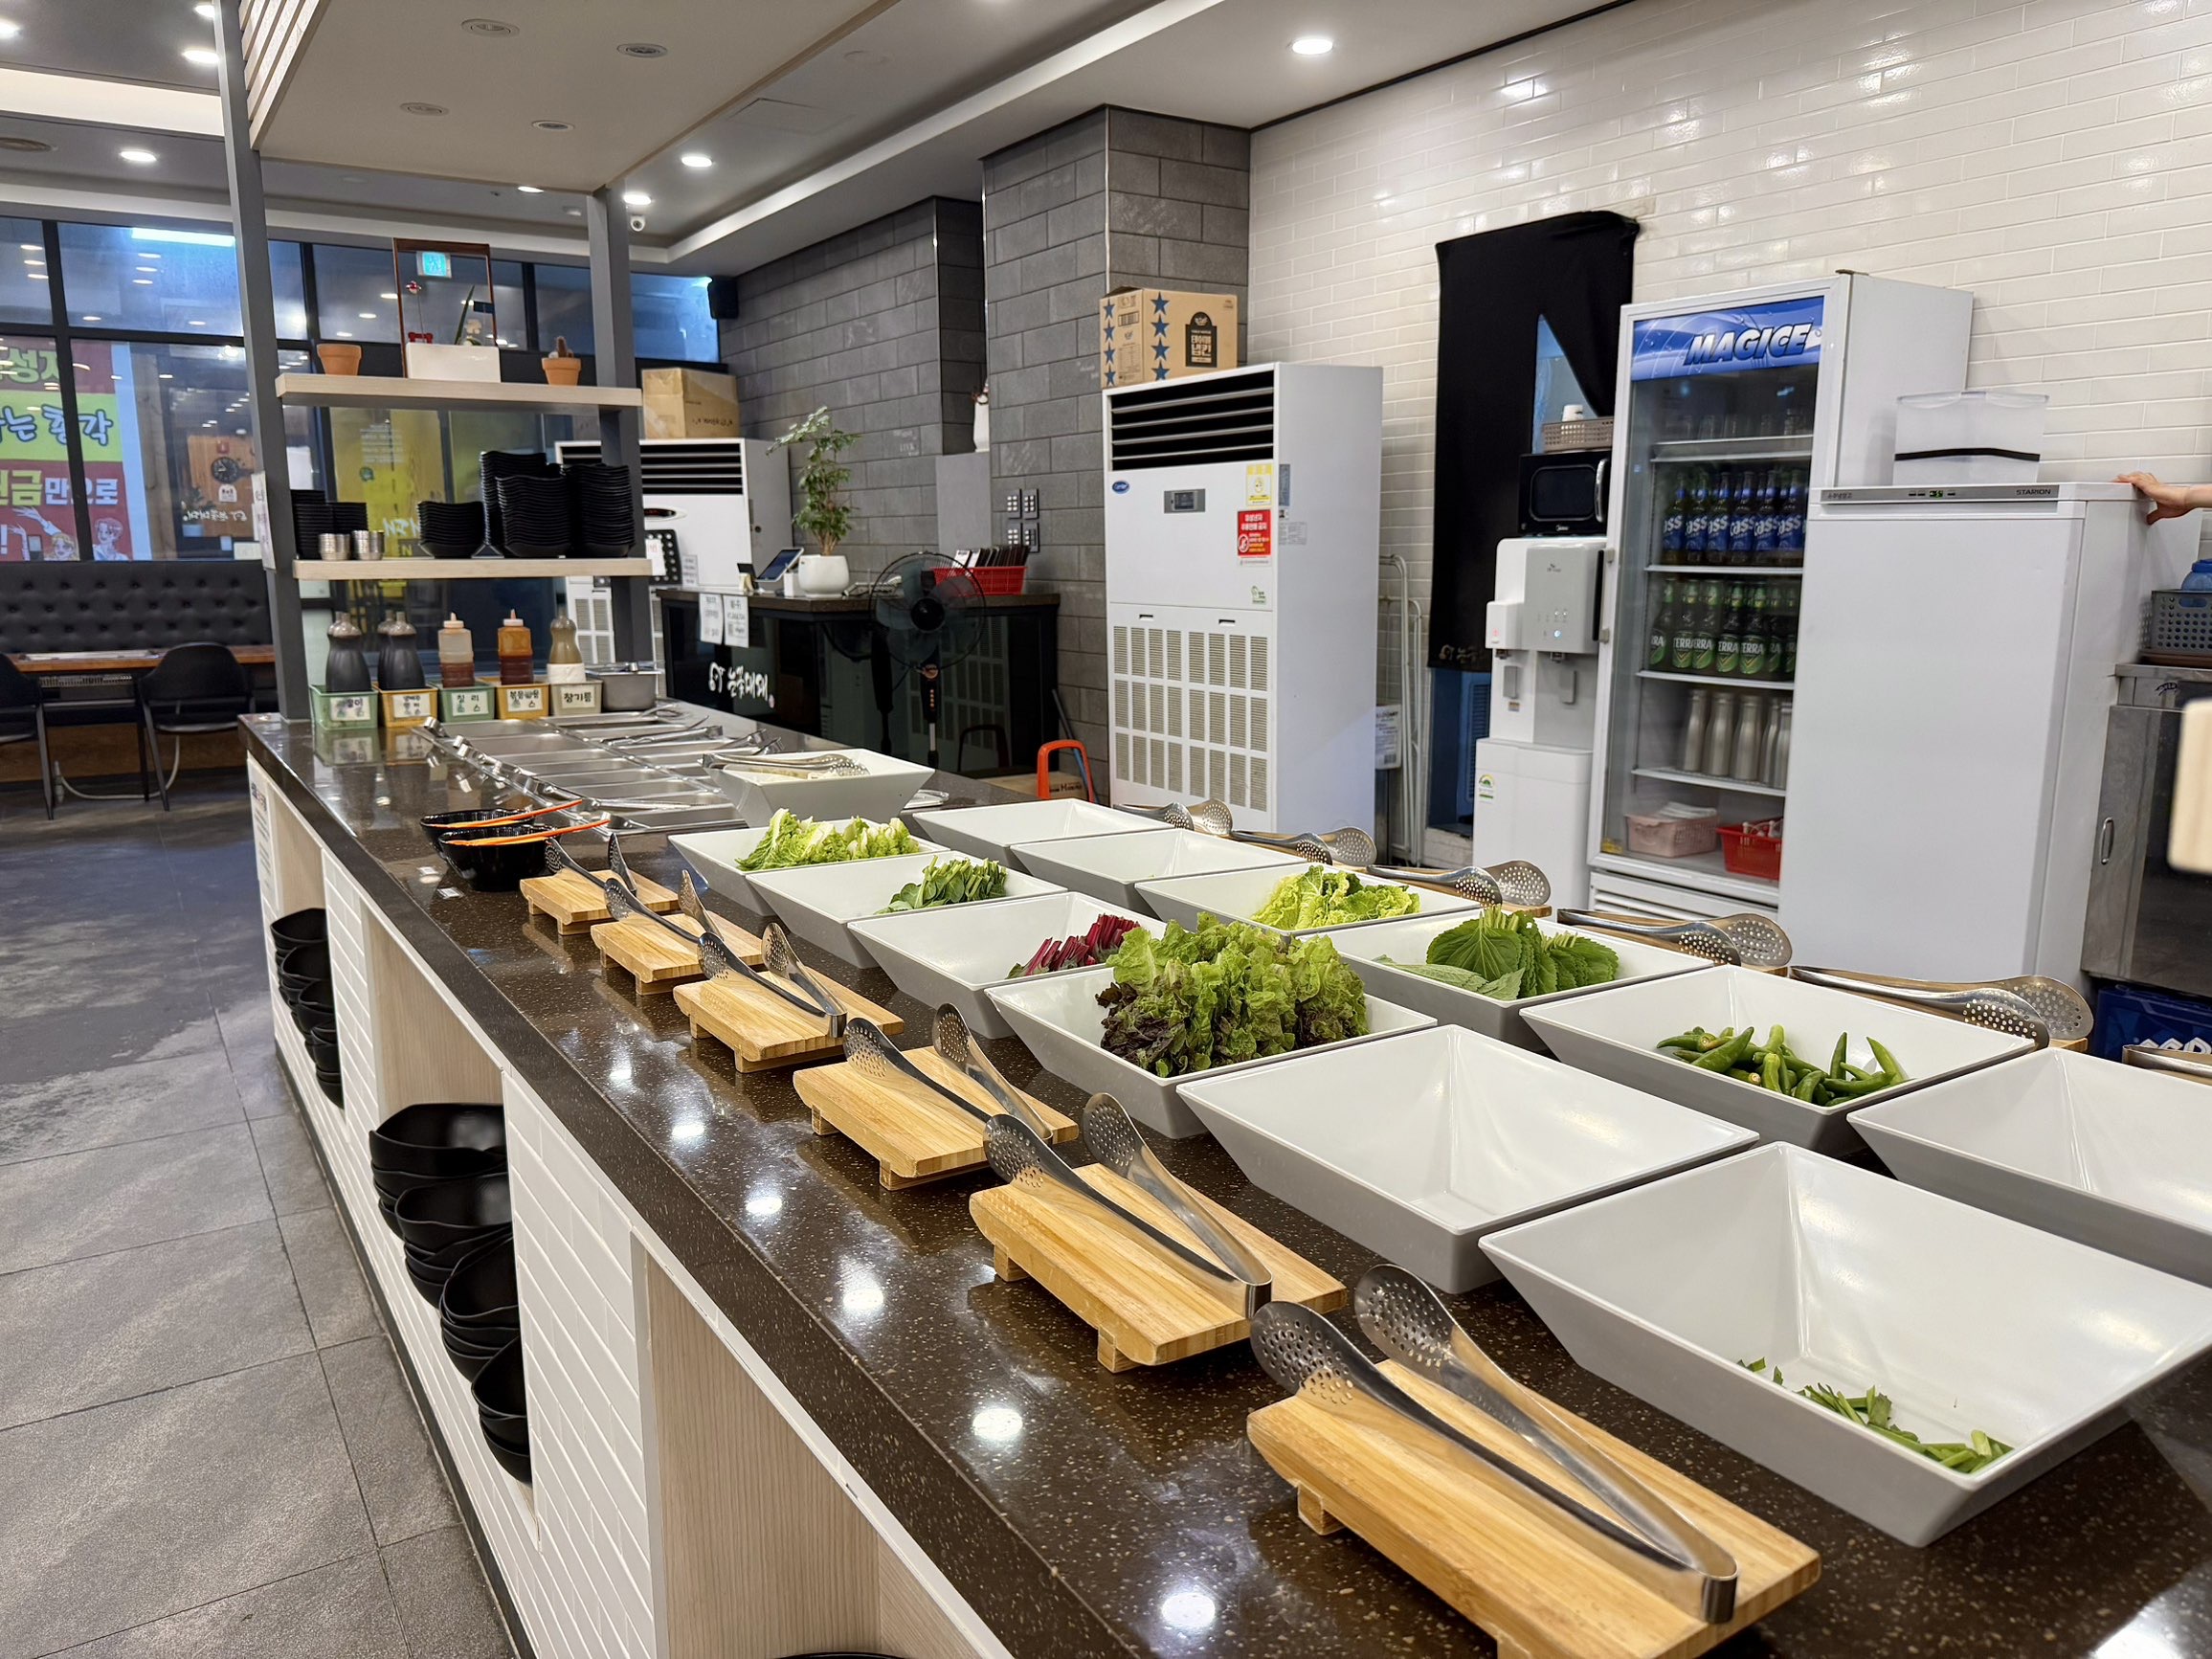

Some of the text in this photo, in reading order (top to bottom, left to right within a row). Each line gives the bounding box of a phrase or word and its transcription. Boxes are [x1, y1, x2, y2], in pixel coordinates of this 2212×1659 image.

[1192, 345, 1212, 356] 냅킨
[1684, 323, 1814, 366] MAGICE
[2016, 488, 2051, 497] STARION
[1718, 640, 1739, 654] ERRA
